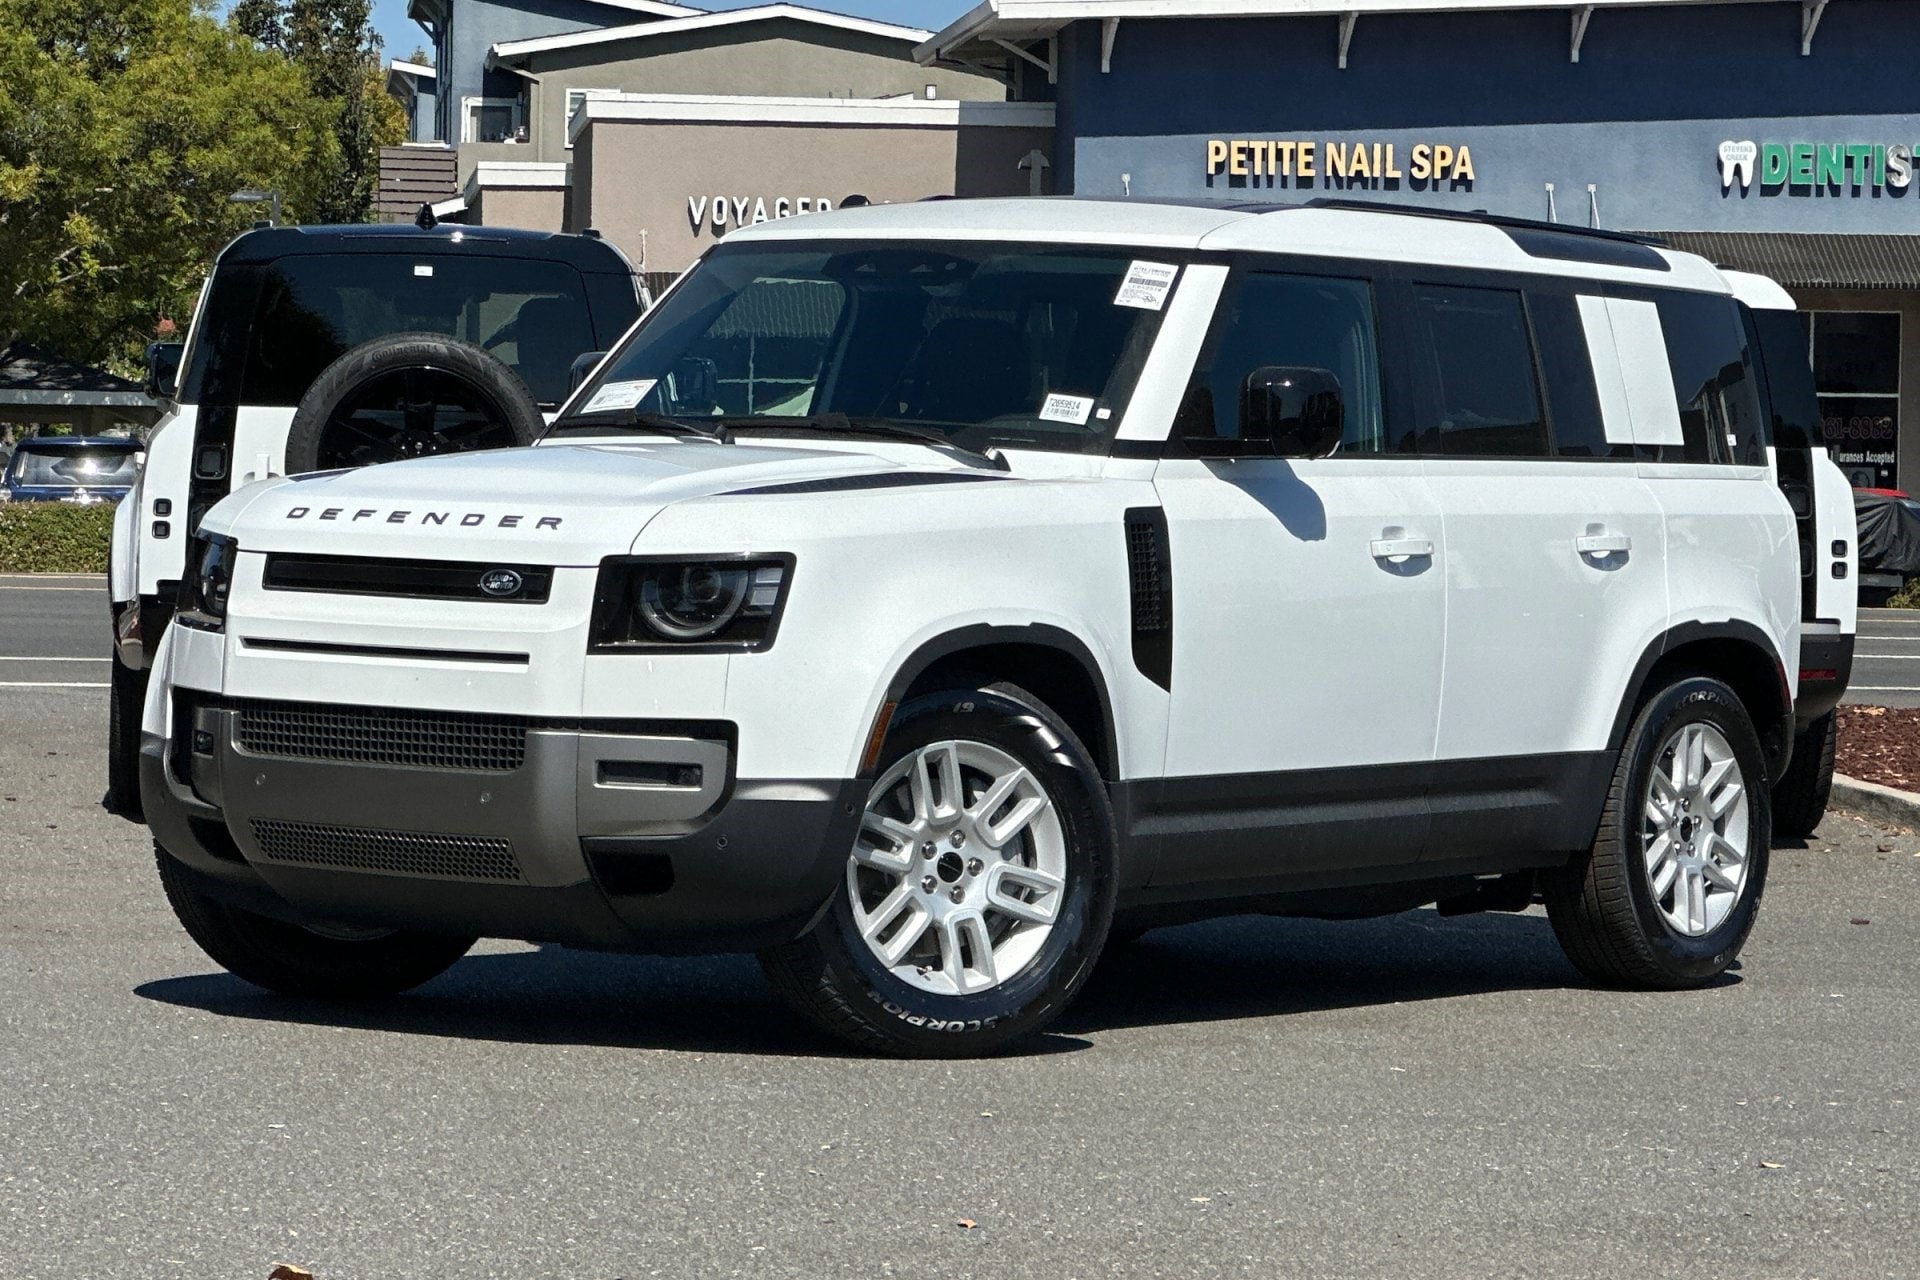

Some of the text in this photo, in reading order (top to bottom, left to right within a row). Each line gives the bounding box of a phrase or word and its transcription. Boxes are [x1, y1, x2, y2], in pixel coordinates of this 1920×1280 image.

[1207, 140, 1476, 180] PETITE NAIL SPA
[1865, 450, 1895, 466] Accepted
[286, 507, 563, 530] DEFENDER
